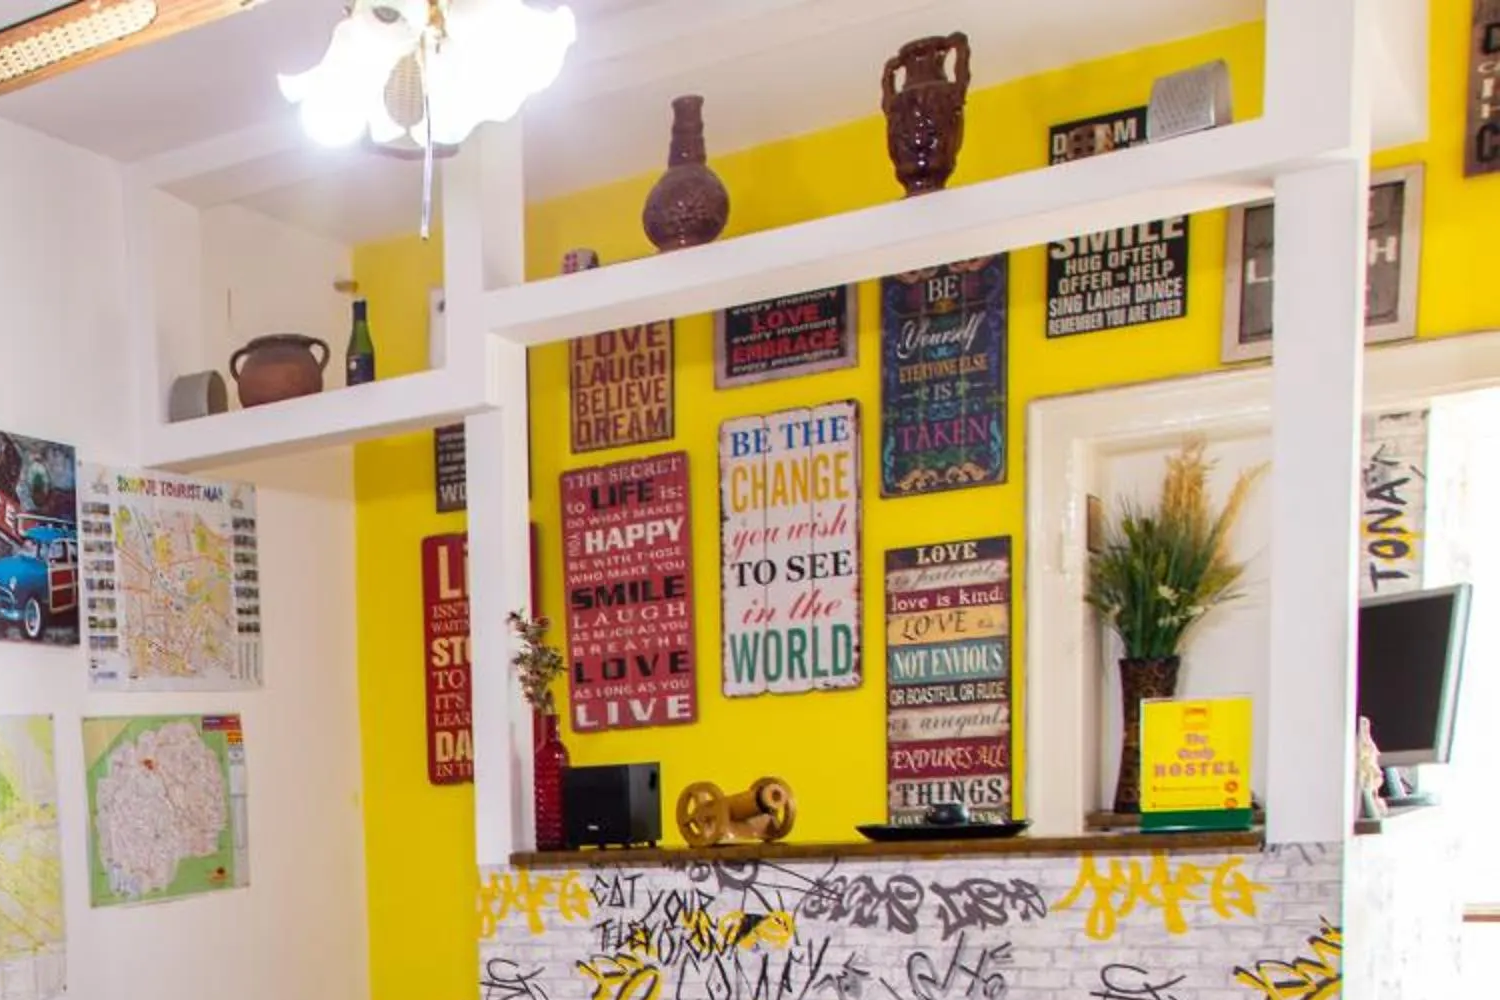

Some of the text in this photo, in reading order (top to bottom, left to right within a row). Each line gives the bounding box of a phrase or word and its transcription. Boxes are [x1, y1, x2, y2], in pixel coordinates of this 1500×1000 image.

[1065, 242, 1168, 277] HUG OFTEN
[927, 273, 961, 303] BE
[1058, 259, 1176, 295] OFFER HELP
[1049, 276, 1184, 318] SING LAUGH DANCE
[731, 316, 837, 344] every moment
[751, 303, 820, 333] LOVE
[1048, 311, 1104, 337] REMEMBER
[576, 321, 666, 360] LOVE
[732, 327, 839, 363] EMBRACE
[896, 311, 988, 359] Yourself
[576, 349, 666, 389] LAUGH
[577, 376, 665, 416] BELIEVE
[933, 382, 953, 401] IS
[577, 407, 666, 446] DREAM
[729, 415, 850, 458] BE THE
[896, 413, 990, 452] TAKEN
[564, 457, 682, 489] THE SECRET
[729, 450, 850, 513] CHANGE
[160, 480, 202, 500] TOURIST
[591, 478, 655, 511] LIFE
[588, 510, 628, 526] WHAT
[633, 502, 684, 519] MAKES
[584, 516, 685, 555] HAPPY
[730, 503, 847, 562] you wish
[568, 560, 587, 571] BE
[593, 554, 631, 569] WITH
[730, 549, 853, 588] TO SEE
[915, 541, 979, 565] LOVE
[570, 559, 685, 584] WHO MAKE YOU
[571, 575, 686, 611] SMILE
[741, 588, 843, 625] in the
[891, 592, 929, 612] love
[936, 593, 951, 607] is
[572, 620, 688, 642] AS MUCH AS YOU
[573, 601, 686, 629] LAUGH
[901, 609, 967, 641] LOVE
[573, 633, 687, 657] BREATHE
[729, 622, 853, 684] WORLD
[893, 642, 1003, 679] NOT ENVIOUS
[432, 668, 467, 690] TO
[574, 650, 690, 684] LOVE
[574, 679, 689, 699] AS LONG AS YOU
[890, 688, 905, 706] OR
[960, 683, 975, 701] OR
[575, 693, 692, 728] LIVE
[436, 762, 453, 777] IN
[892, 745, 974, 774] ENDURES
[895, 777, 1003, 808] THINGS
